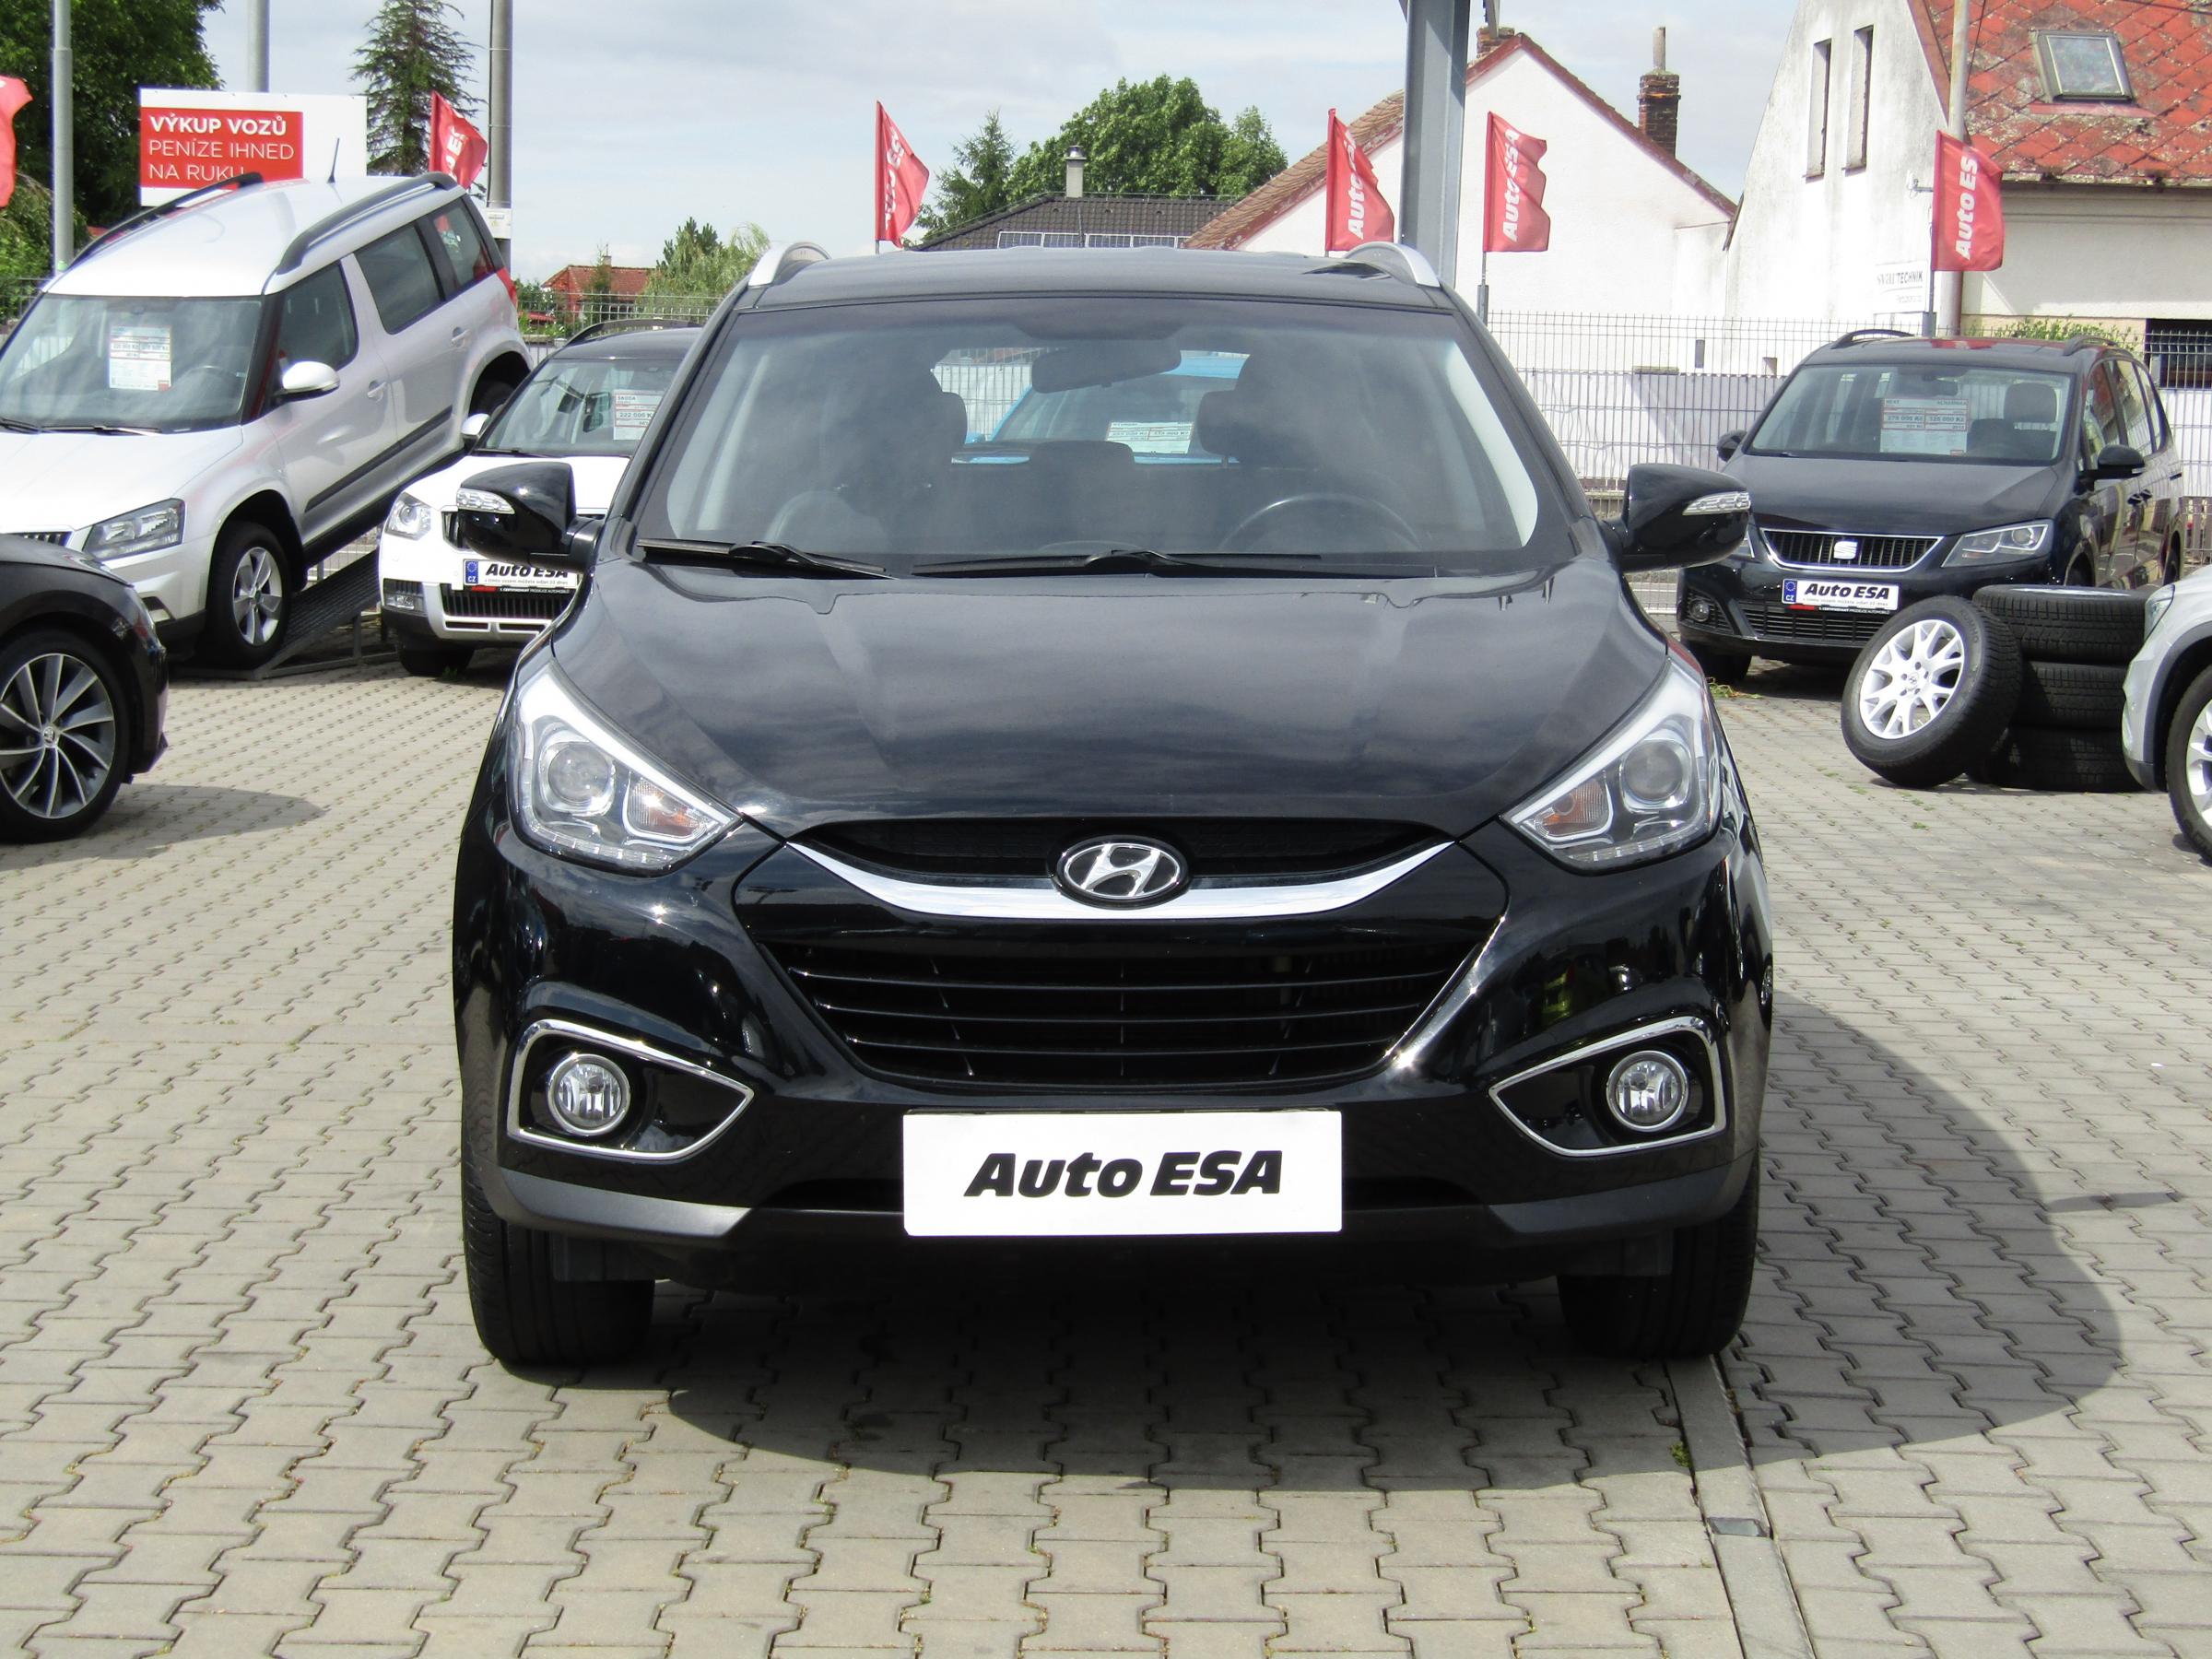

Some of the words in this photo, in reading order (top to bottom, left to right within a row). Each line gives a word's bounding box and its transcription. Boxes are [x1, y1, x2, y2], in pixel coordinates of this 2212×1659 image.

[149, 112, 222, 134] VÝKUP
[228, 115, 287, 136] VOZŮ
[149, 138, 224, 158] PENÍZE
[230, 142, 294, 159] IHNED
[149, 164, 180, 180] NA
[1959, 156, 1978, 191] ES
[1502, 177, 1520, 242] Auto
[1955, 192, 1975, 261] Auto
[485, 563, 532, 578] Auto
[1805, 582, 1852, 598] Auto
[1853, 585, 1890, 600] ESA
[963, 1151, 1144, 1198] Auto
[1149, 1149, 1283, 1196] ESA
